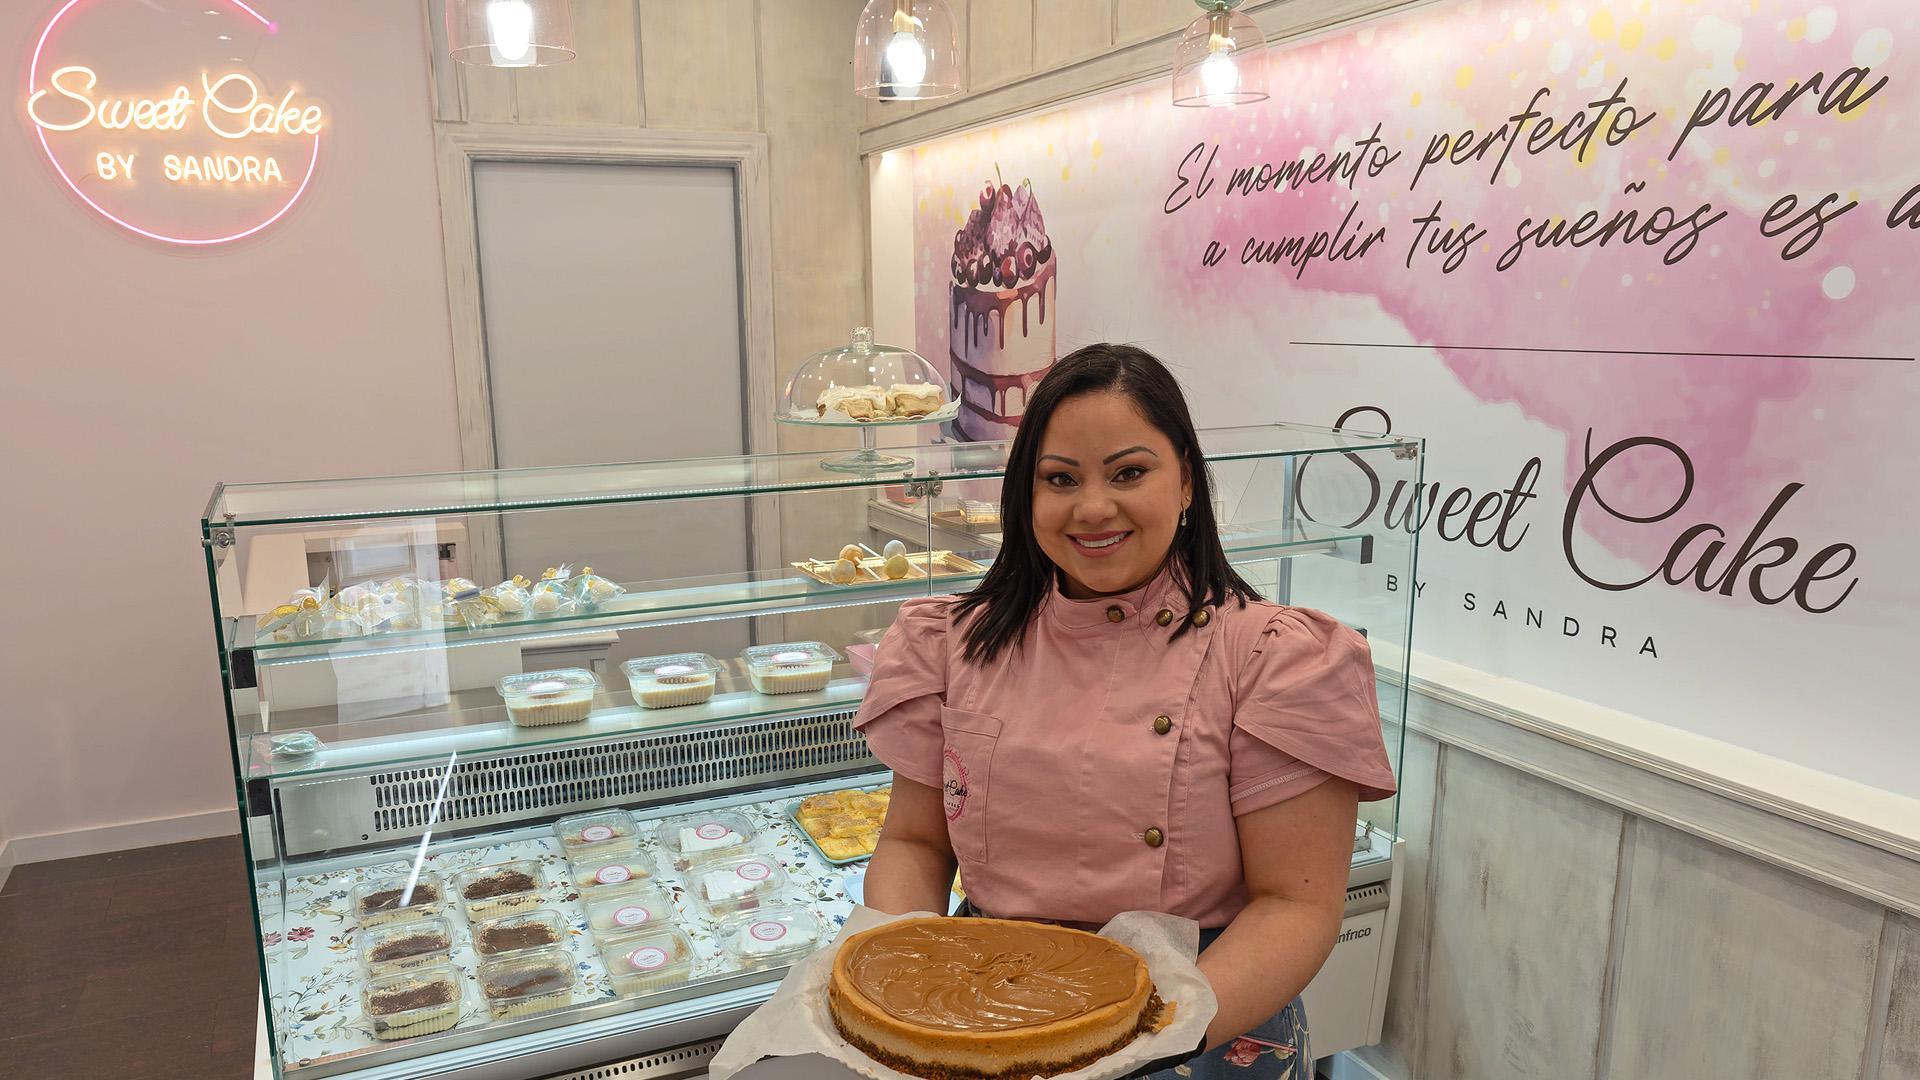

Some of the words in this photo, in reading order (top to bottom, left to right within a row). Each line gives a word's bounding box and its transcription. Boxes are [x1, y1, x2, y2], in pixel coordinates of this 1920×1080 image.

[28, 66, 194, 131] Sweet
[201, 73, 322, 139] Cake
[1164, 142, 1219, 214] El
[1226, 122, 1401, 196] momento
[1410, 77, 1657, 191] perfecto
[1667, 67, 1889, 161] para
[96, 152, 135, 180] BY
[164, 155, 282, 182] SANDRA
[1202, 239, 1226, 267] a
[1241, 201, 1386, 280] cumplir
[1406, 200, 1487, 274] tus
[1496, 181, 1728, 272] sueños
[1760, 193, 1858, 260] es
[1295, 405, 1542, 552] Sweet
[1563, 427, 1858, 613] Cake
[1386, 574, 1426, 598] BY
[1463, 592, 1658, 658] SANDRA
[1338, 927, 1371, 943] nfrico
